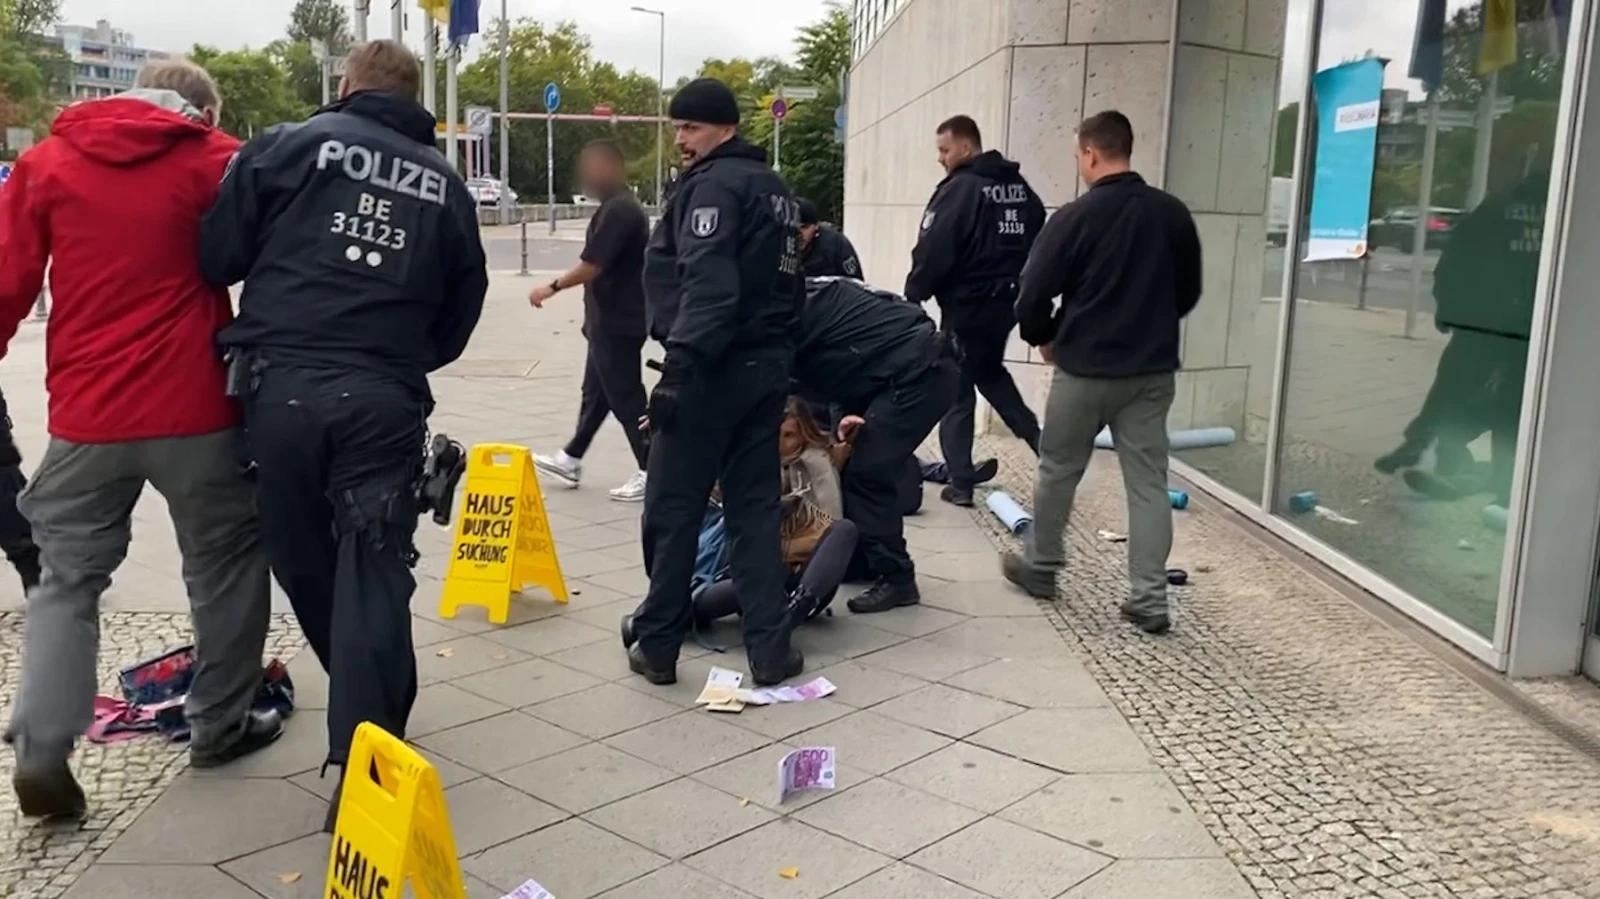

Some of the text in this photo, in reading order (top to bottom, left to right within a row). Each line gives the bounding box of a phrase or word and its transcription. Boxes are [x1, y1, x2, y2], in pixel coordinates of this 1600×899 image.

[316, 139, 448, 206] POLIZEI
[357, 192, 392, 221] BE
[330, 211, 407, 250] 31123
[466, 493, 515, 516] HAUS
[462, 518, 512, 539] DURCH
[457, 543, 509, 564] SUCHUNG
